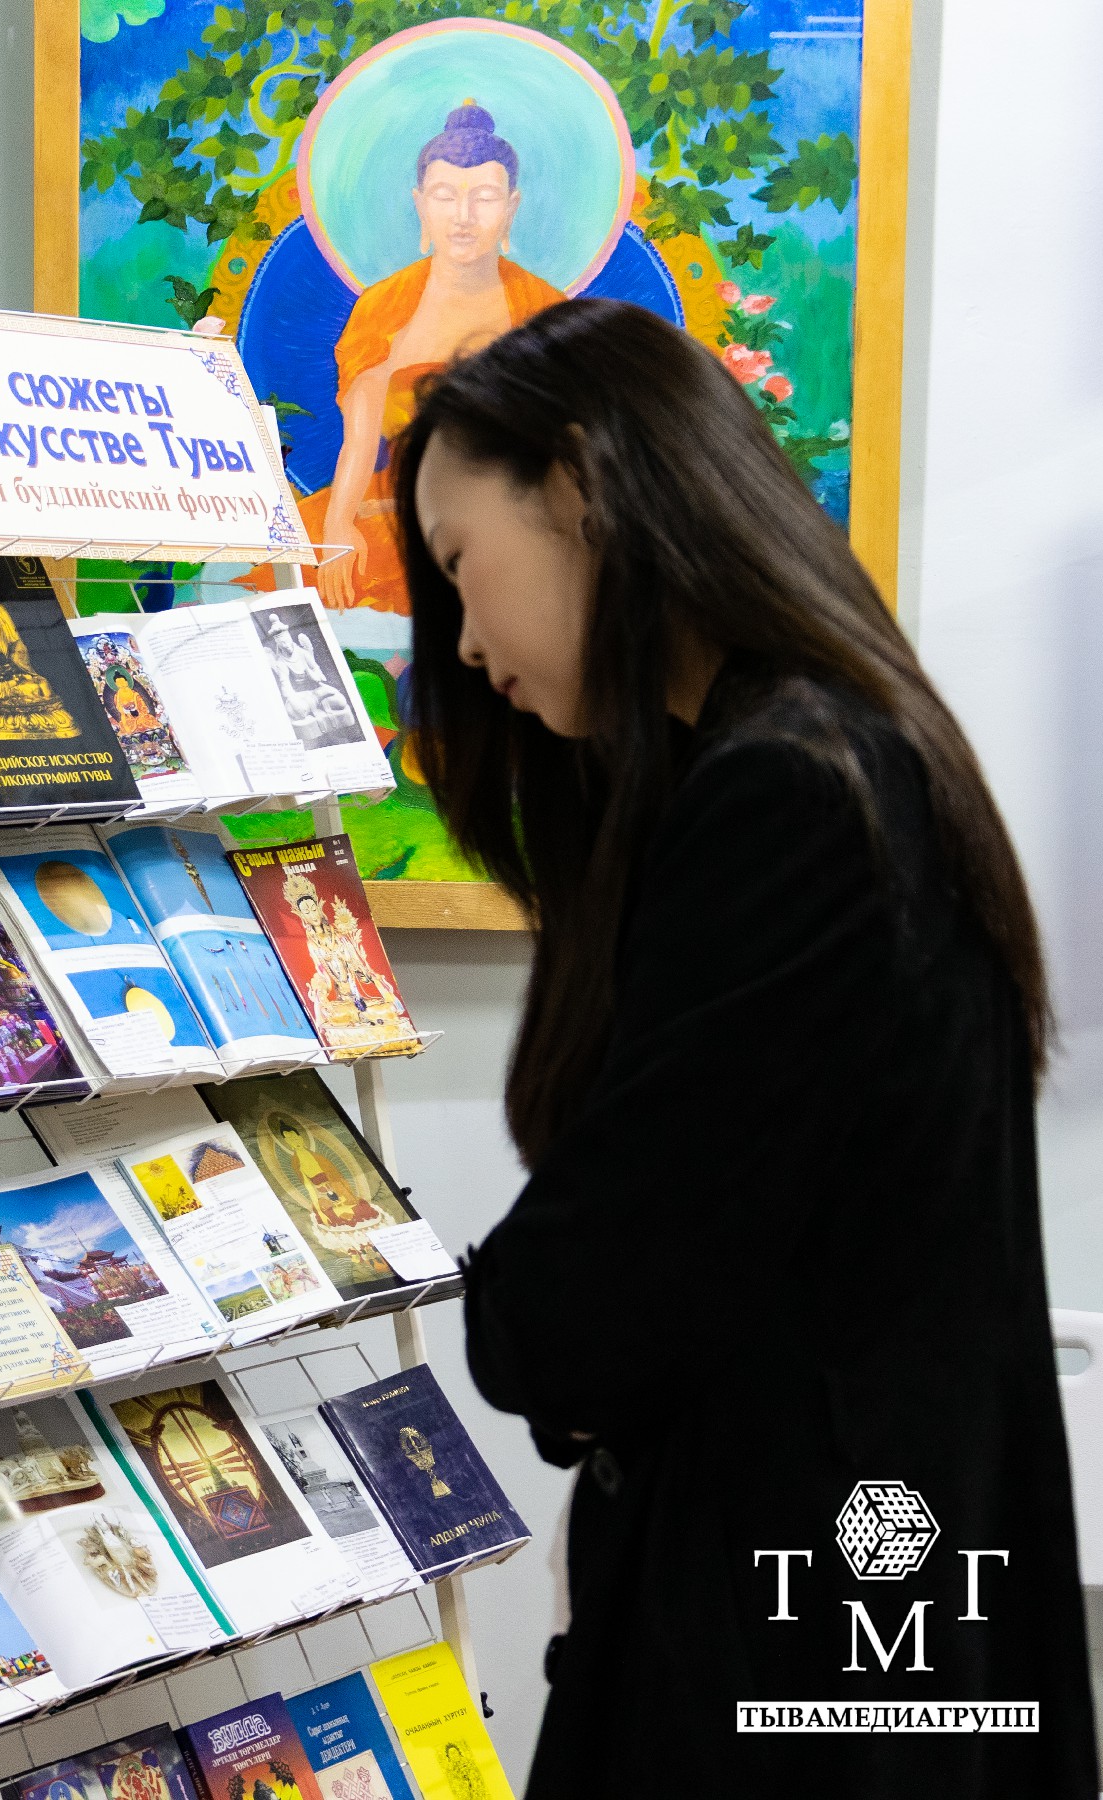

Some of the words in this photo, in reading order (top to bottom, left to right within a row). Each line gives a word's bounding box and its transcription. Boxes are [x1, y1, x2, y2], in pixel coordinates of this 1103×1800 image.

[7, 371, 174, 418] сюжеты
[148, 421, 256, 480] Тувы
[12, 476, 172, 513] буддийский
[177, 486, 269, 523] форум)
[2, 772, 81, 787] ИКОНОГРАФИЯ
[81, 770, 113, 782] ТУВЫ
[48, 752, 113, 767] ИСКУССТВО
[429, 1523, 470, 1548] АЛДЫН
[468, 1510, 503, 1529] ЧУЛА
